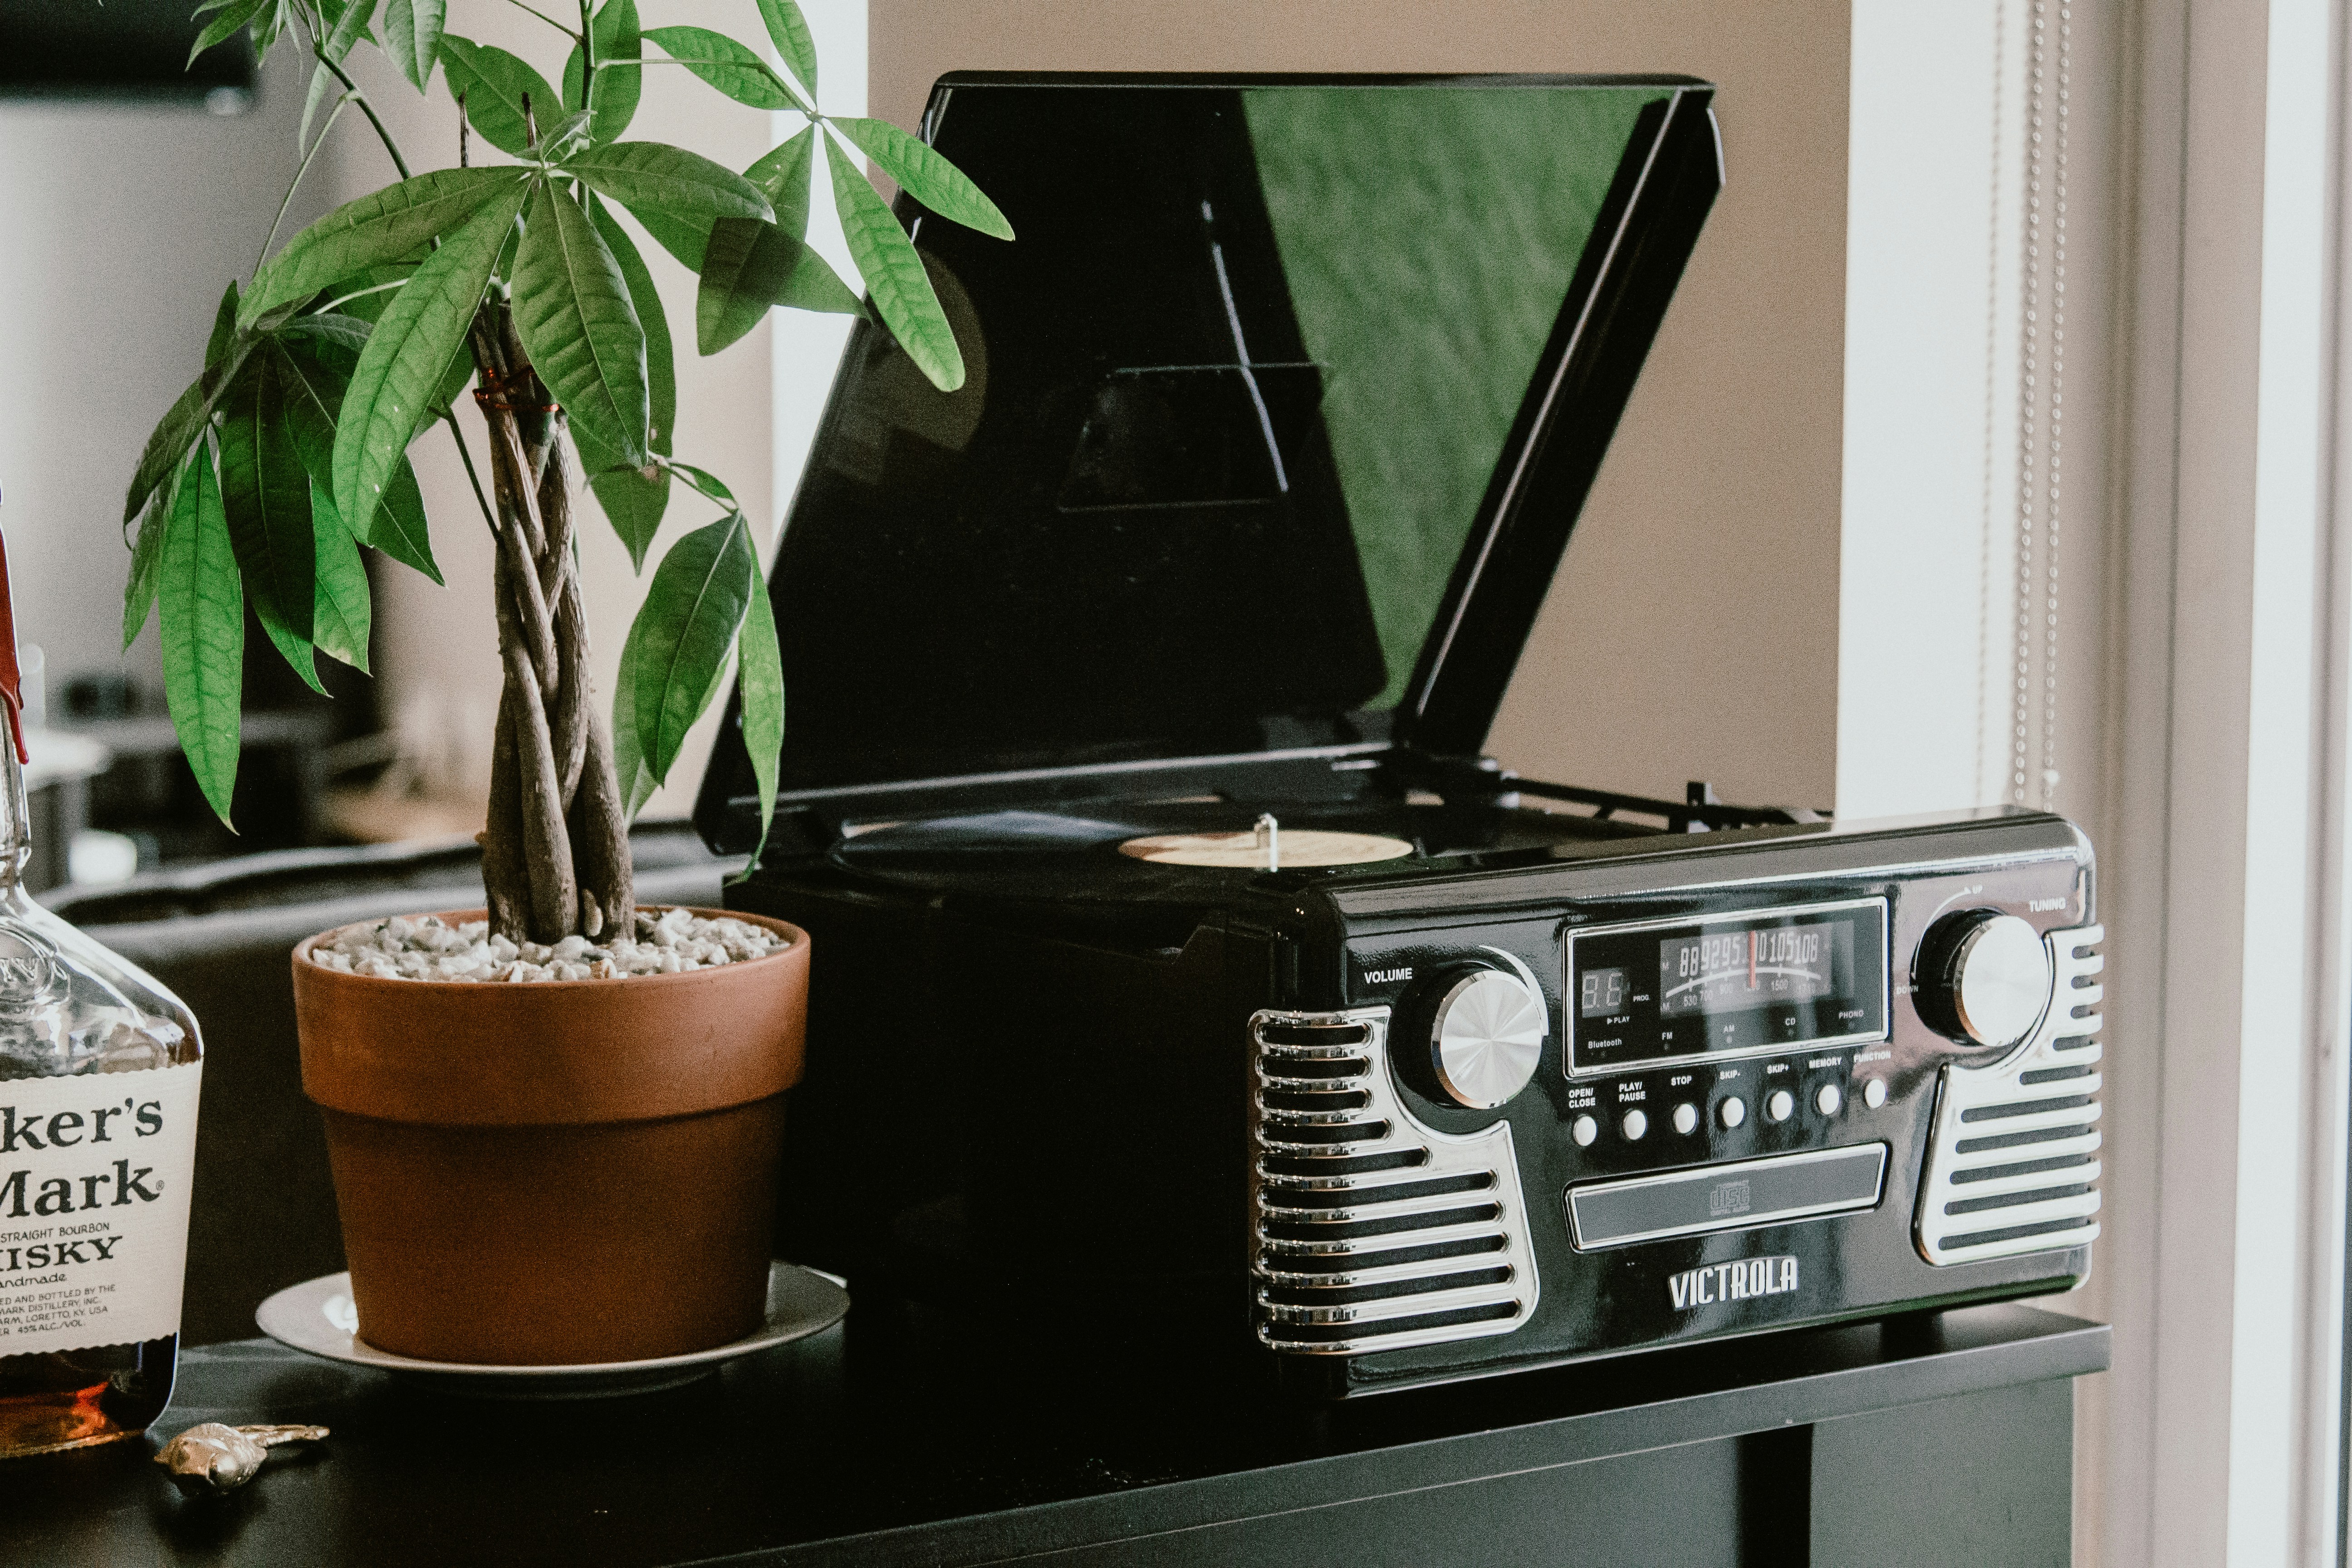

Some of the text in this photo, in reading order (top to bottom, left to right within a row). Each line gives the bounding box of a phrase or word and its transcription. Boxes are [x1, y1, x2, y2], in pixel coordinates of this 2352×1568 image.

[1972, 885, 1983, 894] UP
[2029, 897, 2066, 912] TUNING
[1680, 946, 1700, 977] 88
[1701, 940, 1720, 970] 92
[1722, 936, 1741, 967] 95
[1769, 932, 1795, 963] 105
[1794, 933, 1819, 965] 108
[1364, 967, 1412, 984] VOLUME
[1896, 985, 1919, 995] DOWN
[1838, 1009, 1864, 1019] PHONO
[1785, 1017, 1796, 1026] CD
[1724, 1024, 1735, 1033] AM
[1661, 1031, 1673, 1040] FM
[1588, 1038, 1622, 1049] Bluetooth
[1853, 1050, 1891, 1063] FUNCTION
[1809, 1057, 1842, 1069] MEMORY
[1671, 1075, 1692, 1086] STOP
[1568, 1088, 1594, 1098] OPEN/
[1619, 1082, 1642, 1093] PLAY/
[1619, 1091, 1646, 1102] PAUSE
[1568, 1097, 1596, 1109] CLOSE
[0, 1222, 110, 1243] STRAIGHT BOURBON
[0, 1235, 123, 1271] ISKY
[1669, 1258, 1798, 1308] VICTROLA
[15, 1294, 35, 1303] AND
[39, 1289, 81, 1302] BOTTLED
[84, 1287, 96, 1295] BY
[99, 1284, 116, 1293] THE
